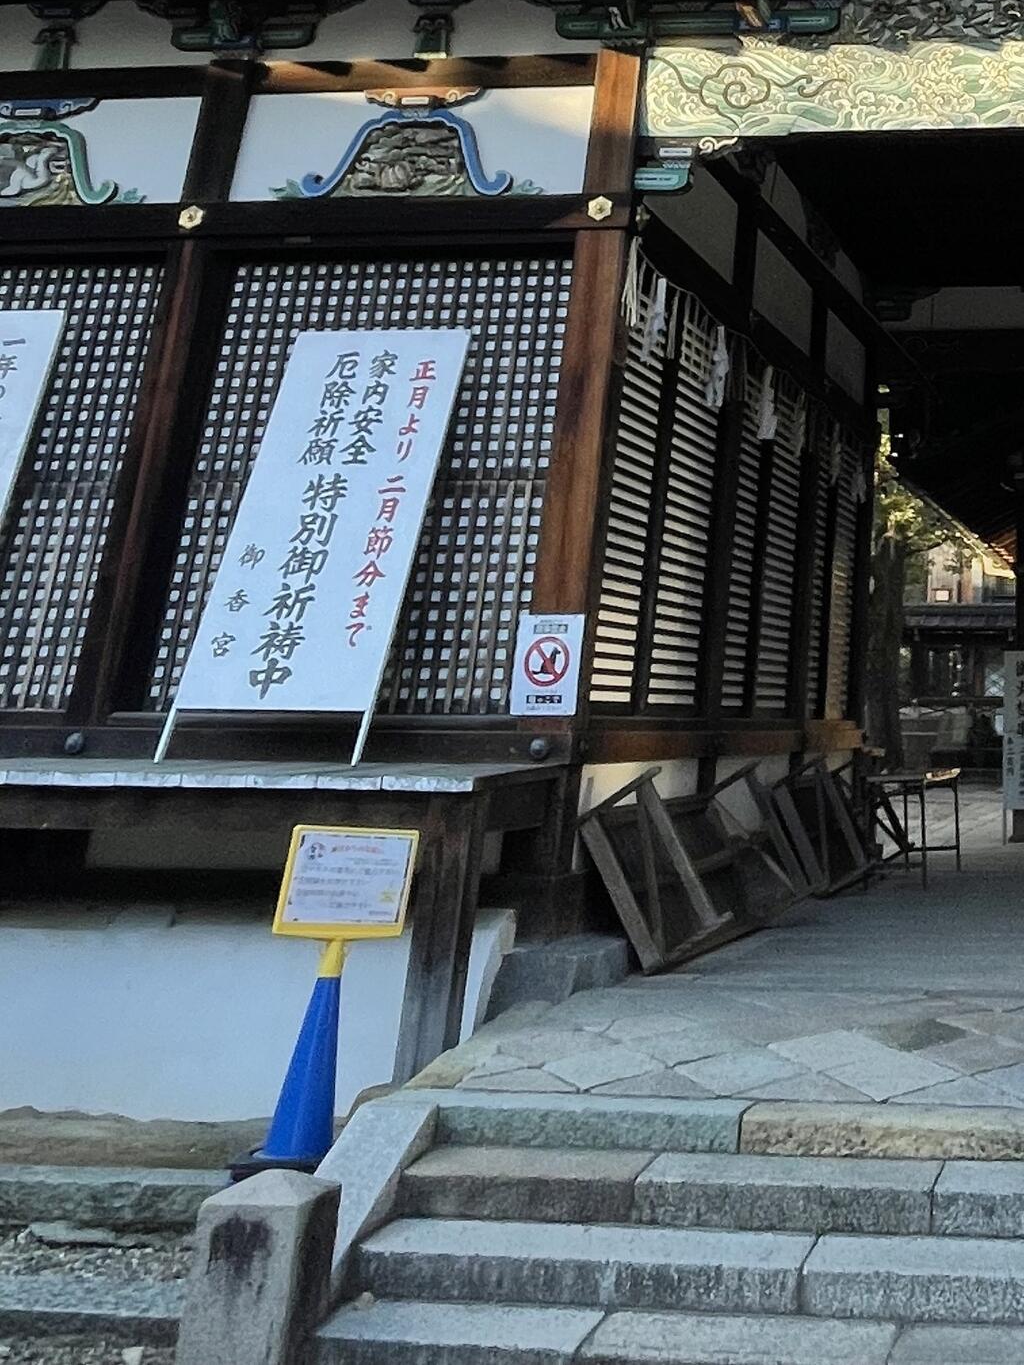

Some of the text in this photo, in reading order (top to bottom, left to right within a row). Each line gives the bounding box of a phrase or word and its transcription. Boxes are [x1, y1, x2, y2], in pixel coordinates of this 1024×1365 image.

[296, 350, 361, 466] 厄除祈願
[339, 349, 399, 466] 家内安全
[344, 360, 437, 648] 正月より 二月節分まで
[210, 542, 266, 658] 御香宮
